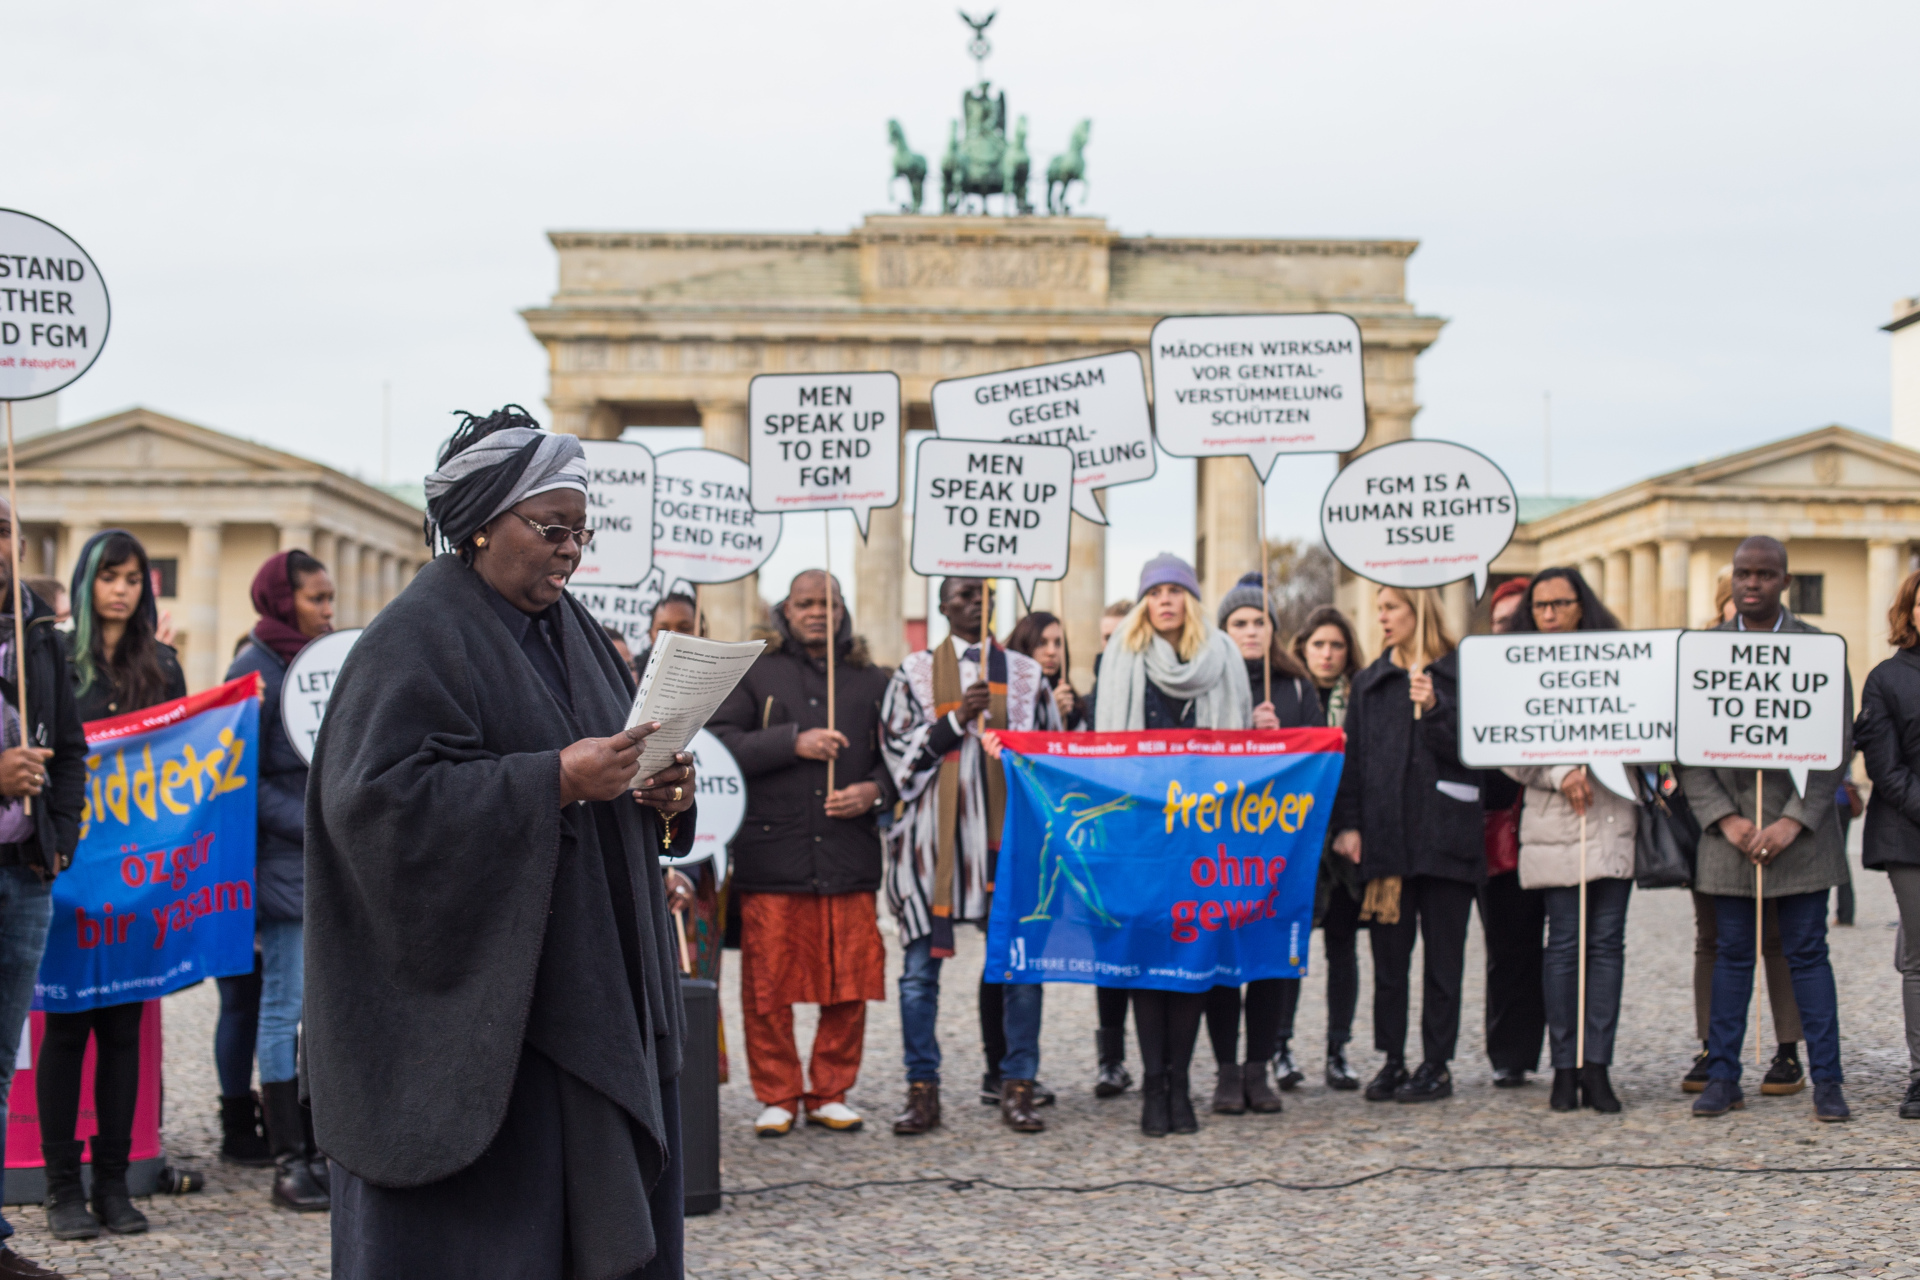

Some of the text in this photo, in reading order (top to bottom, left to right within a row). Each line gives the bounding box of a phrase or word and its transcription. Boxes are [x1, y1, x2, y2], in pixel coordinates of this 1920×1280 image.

[0, 288, 74, 314] THER
[32, 323, 86, 348] FGM
[1161, 339, 1352, 358] MÄDCHEN WIRKSAM
[1193, 364, 1324, 380] VOR GENITAL-
[800, 386, 851, 406] MEN
[974, 368, 1104, 404] GEMEINSAM
[1176, 382, 1342, 403] VERSTÜMMELUNG
[765, 412, 884, 435] SPEAK UP
[1008, 400, 1082, 426] GEGEN
[1212, 405, 1309, 425] SCHÜTZEN
[779, 439, 870, 460] TO END
[1073, 441, 1147, 469] ELUNG
[968, 454, 1023, 475] MEN
[587, 468, 647, 486] KSAM
[655, 475, 693, 496] ET'S
[801, 466, 850, 487] FGM
[1367, 474, 1469, 494] FGM IS A
[931, 478, 1056, 503] SPEAK UP
[945, 506, 1040, 529] TO END
[1328, 496, 1511, 522] HUMAN RIGHTS
[672, 525, 714, 546] END
[721, 531, 763, 552] FGM
[964, 533, 1017, 554] FGM
[1387, 525, 1453, 544] ISSUE
[1506, 643, 1651, 663] GEMEINSAM
[1732, 645, 1790, 665] MEN
[1540, 671, 1619, 688] GEGEN
[1694, 670, 1828, 692] SPEAK UP
[1525, 697, 1634, 715] GENITAL-
[1708, 697, 1811, 719] TO END
[1473, 719, 1674, 744] VERSTÜMMELUN
[1731, 725, 1787, 745] FGM
[695, 776, 739, 795] HTS
[1162, 780, 1228, 834] frei
[1190, 843, 1287, 888] ohne
[75, 903, 136, 949] bir
[1028, 957, 1066, 971] TERRE
[1068, 957, 1094, 973] DES
[1095, 962, 1141, 977] FEMMES
